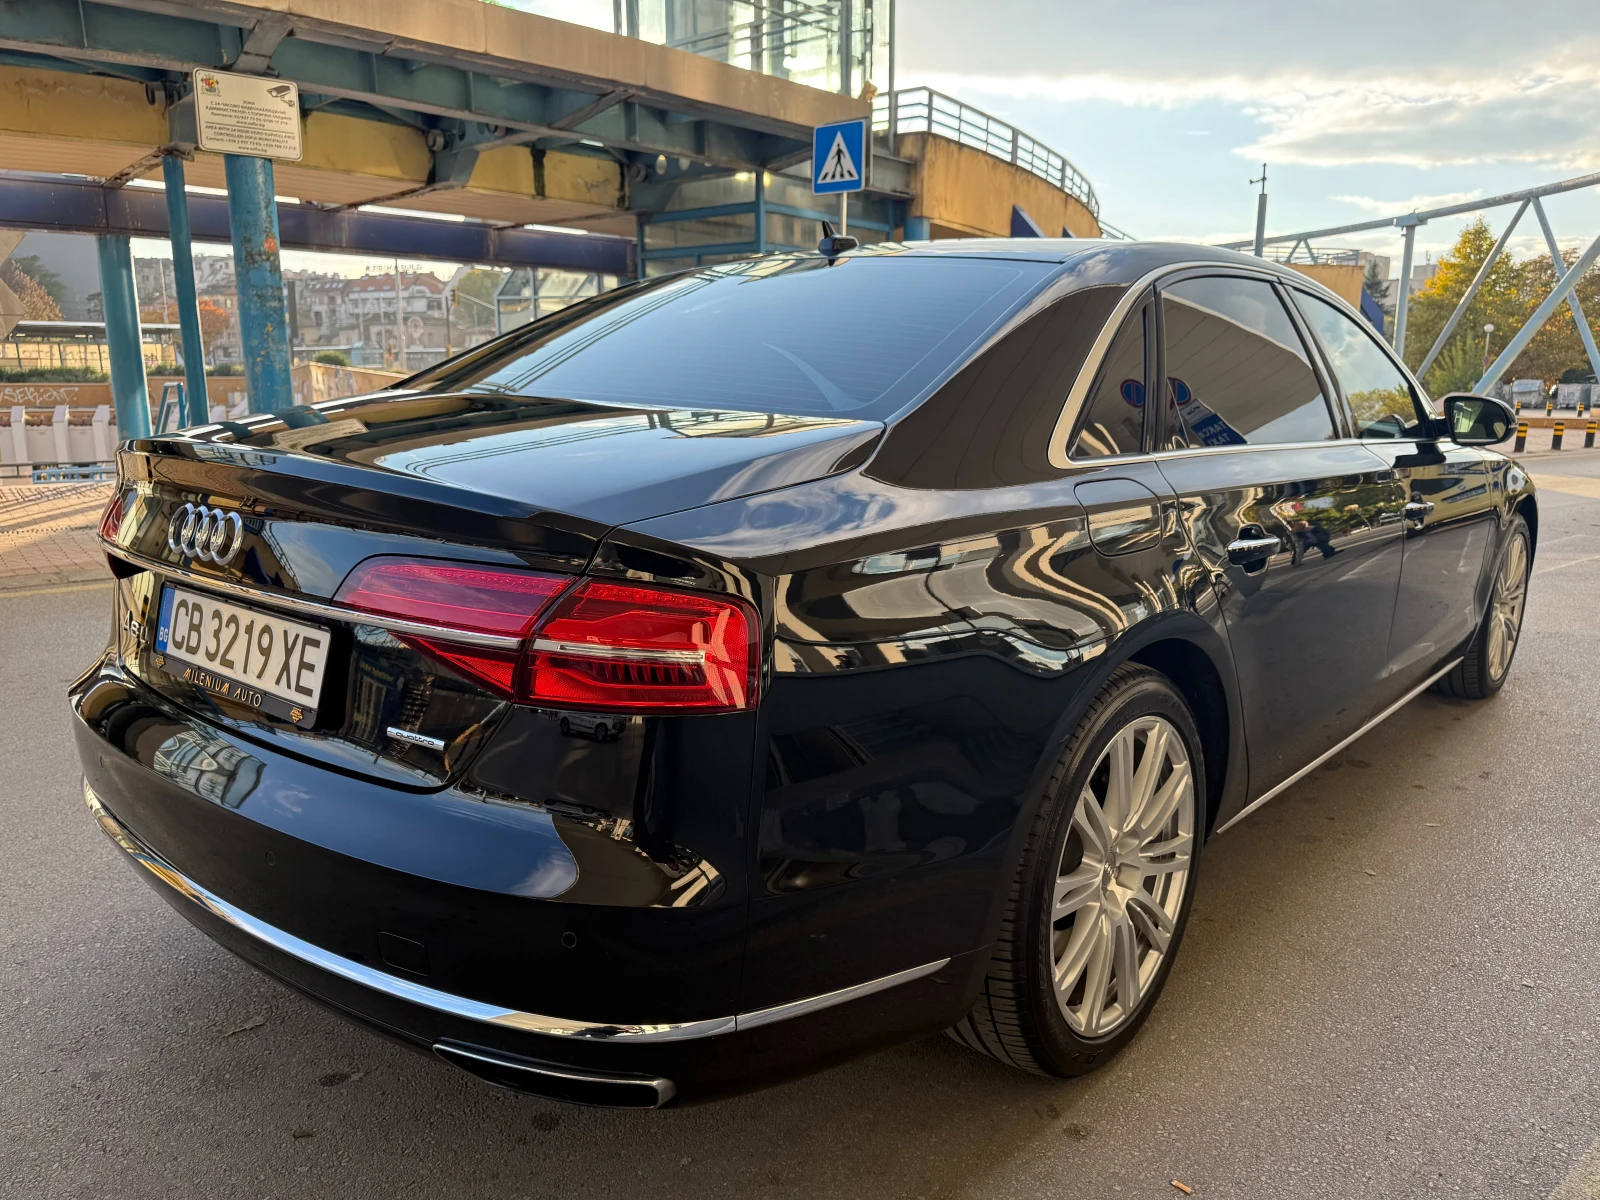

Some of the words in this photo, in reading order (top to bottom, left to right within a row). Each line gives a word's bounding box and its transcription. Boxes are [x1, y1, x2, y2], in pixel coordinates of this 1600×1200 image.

[159, 626, 169, 643] BG
[206, 609, 274, 680] 3219
[182, 668, 230, 696] MILENIUM
[234, 688, 262, 708] AUTO
[396, 732, 434, 746] quattro
